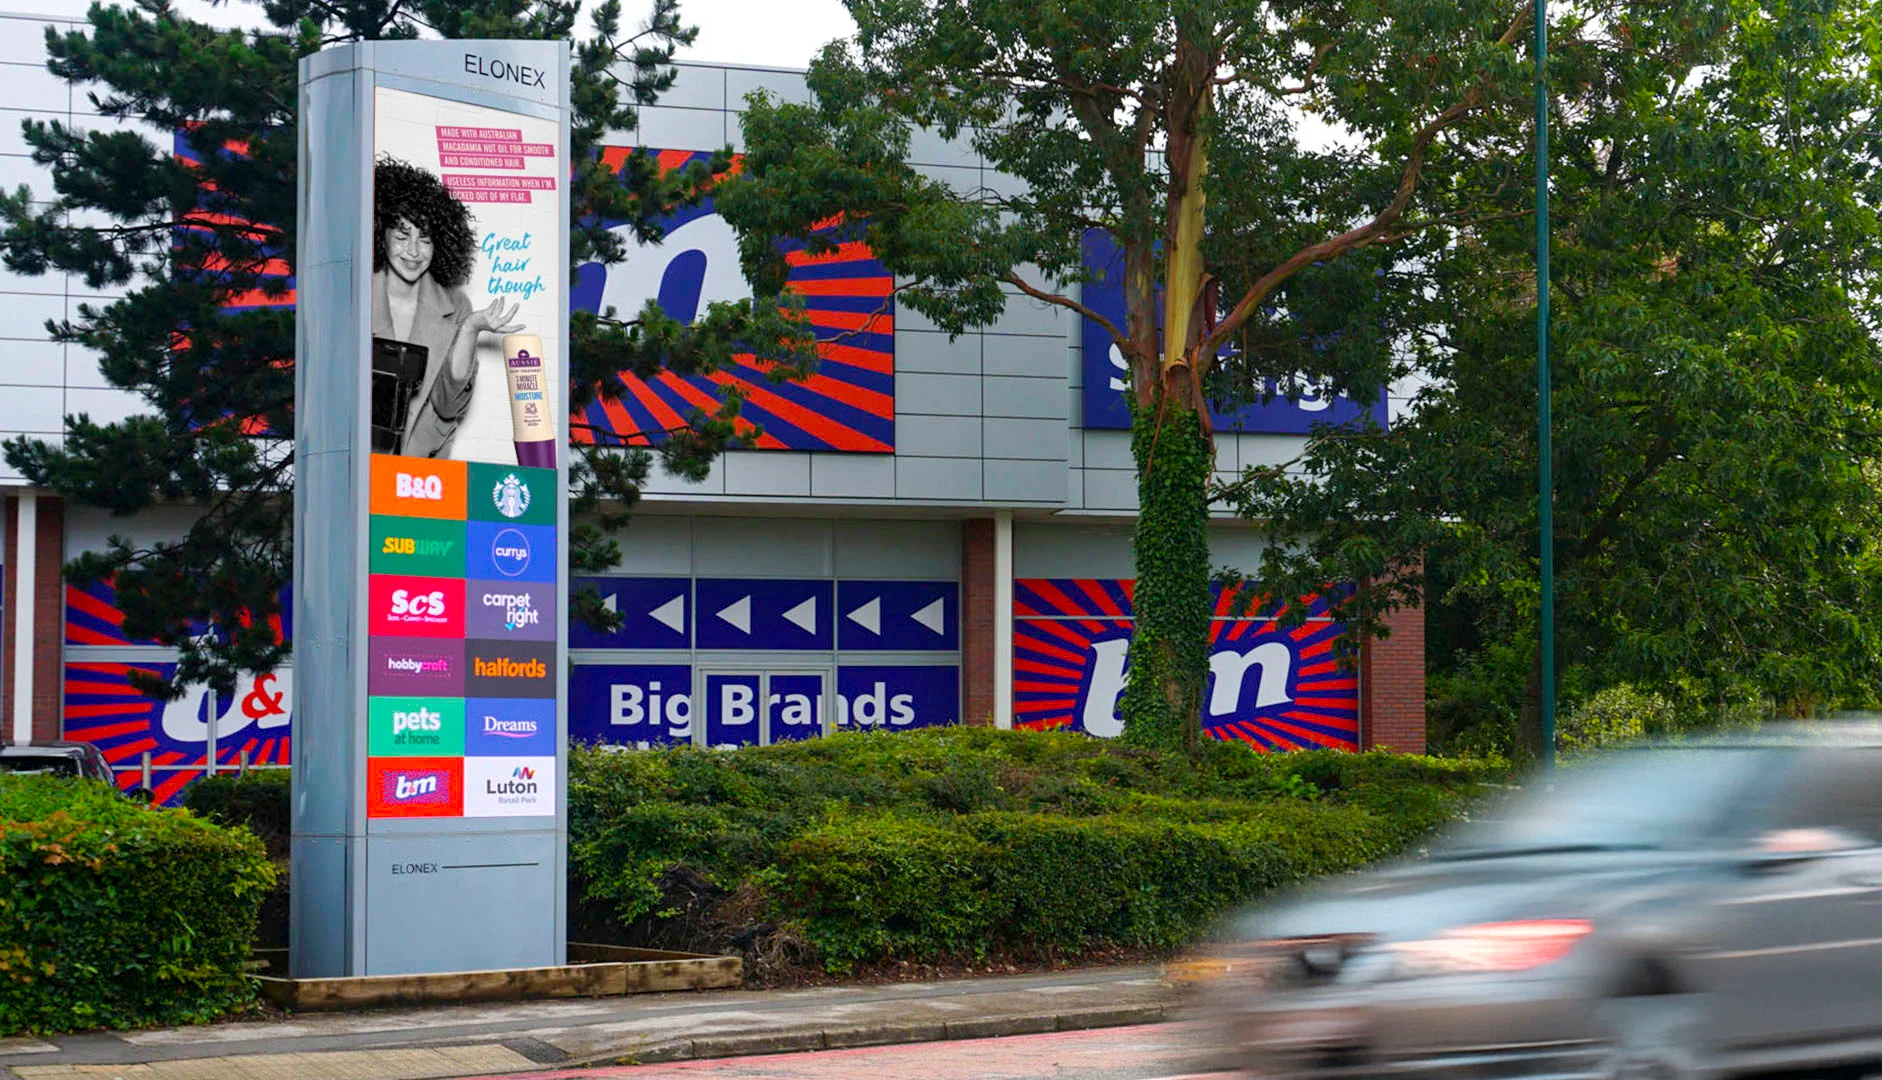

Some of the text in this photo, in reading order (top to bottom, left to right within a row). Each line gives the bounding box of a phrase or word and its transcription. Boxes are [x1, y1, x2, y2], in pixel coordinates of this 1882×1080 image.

[465, 53, 545, 89] ELONEX
[440, 127, 518, 140] MADE WITH AUSTRALIAN
[442, 142, 550, 155] MACADAMIA NUT OIL FOR SMOOTH
[444, 155, 458, 165] AND
[459, 156, 503, 167] CONDITIONED
[446, 175, 476, 186] USELESS
[477, 177, 520, 188] INFORMATION
[521, 178, 540, 188] WHEN
[475, 191, 490, 201] OUT
[490, 191, 499, 201] OF
[499, 192, 510, 201] MY
[481, 231, 531, 260] Great
[491, 255, 531, 273] hair
[487, 274, 546, 301] though
[510, 359, 538, 367] AUSSIE
[519, 374, 537, 382] MINUTE
[516, 382, 538, 391] MIRACLE
[514, 392, 543, 400] MOISTURE
[396, 473, 443, 499] B&Q
[382, 536, 455, 556] SUBWAY
[495, 547, 528, 560] currys
[391, 589, 446, 615] ScS
[483, 593, 530, 611] carpet
[506, 608, 539, 628] right
[387, 657, 448, 673] hobbycraft
[474, 657, 546, 678] halfords
[610, 682, 692, 737] Big
[392, 708, 441, 735] pets
[484, 716, 538, 732] Dreams
[394, 732, 440, 745] at home
[486, 779, 538, 794] Luton
[392, 864, 438, 875] ELONEX
